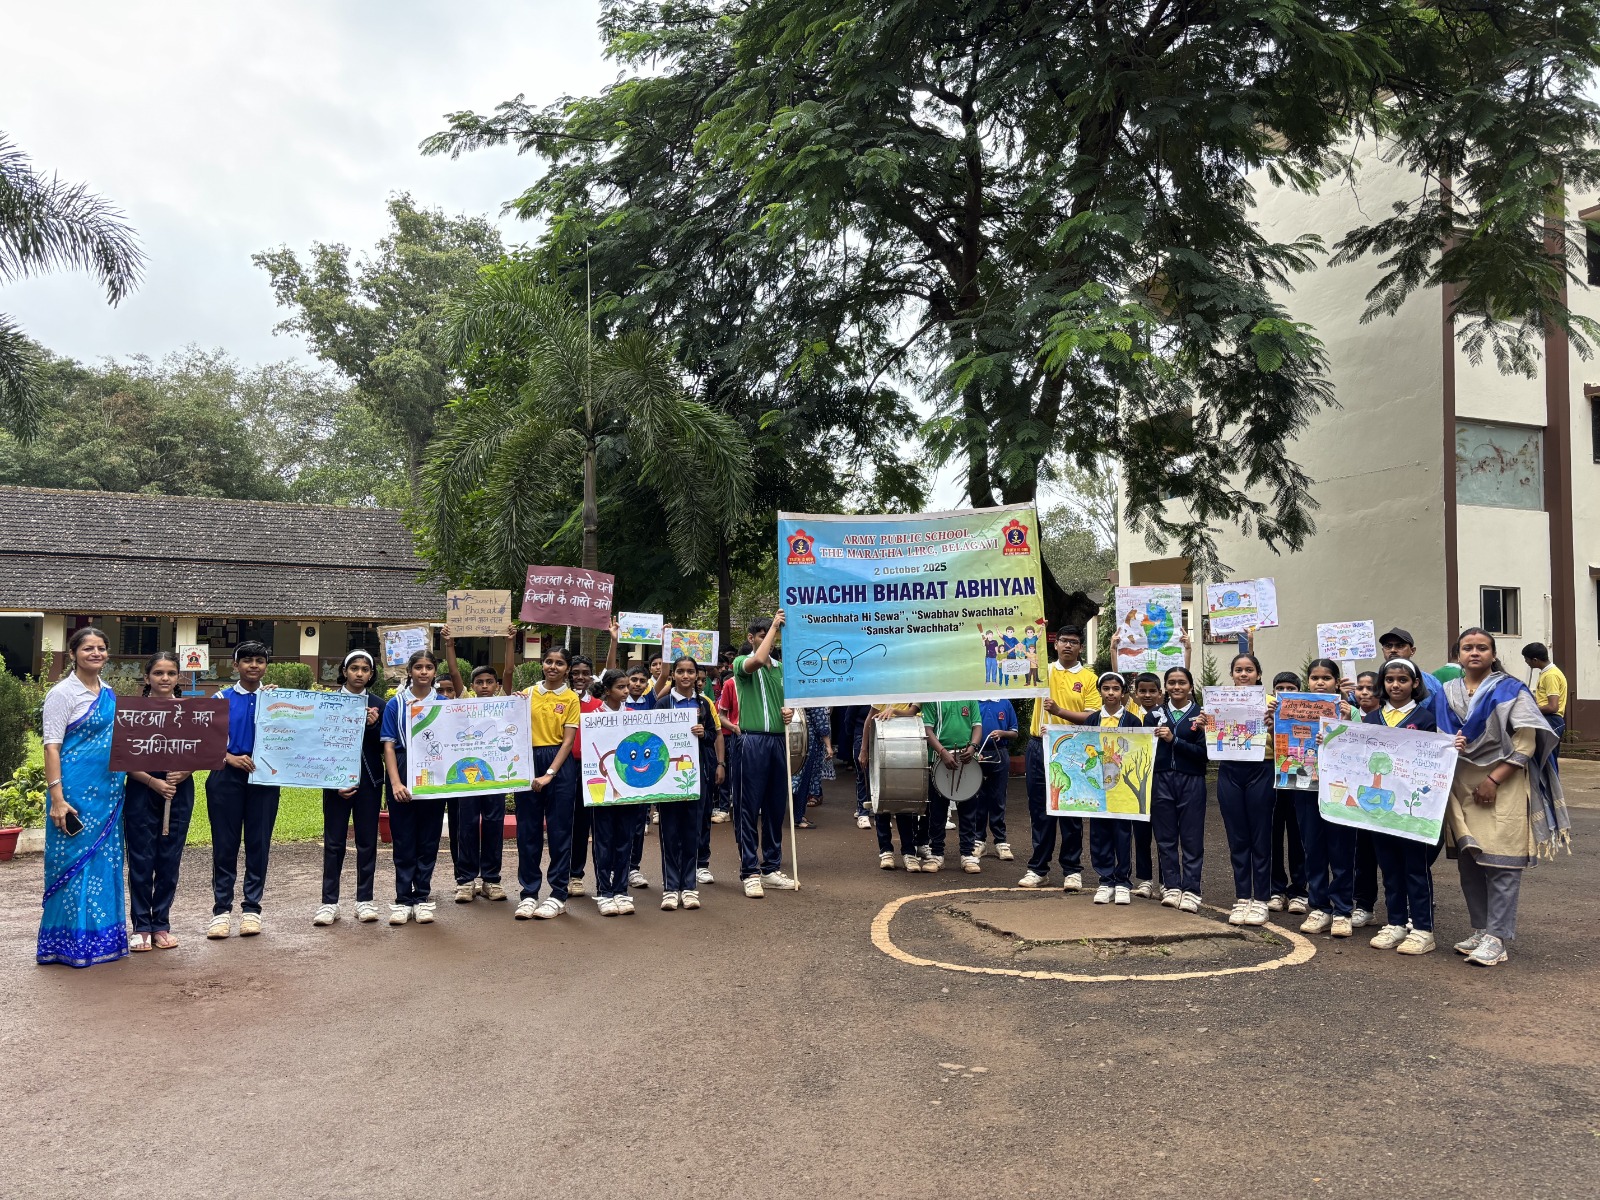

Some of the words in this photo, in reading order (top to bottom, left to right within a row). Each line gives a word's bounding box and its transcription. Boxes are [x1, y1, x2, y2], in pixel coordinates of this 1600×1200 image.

[843, 534, 876, 546] ARMY
[880, 532, 922, 545] PUBLIC
[820, 547, 844, 559] THE
[847, 546, 904, 560] MARATHA
[941, 538, 999, 553] BELAGAVI
[874, 567, 880, 576] 2
[883, 564, 921, 576] October
[923, 561, 947, 573] 2025
[529, 574, 563, 586] स्वच्छता
[564, 573, 574, 587] के
[577, 572, 595, 590] रास्ते
[557, 589, 567, 605] के
[569, 591, 592, 608] वास्ते
[785, 583, 867, 606] SWACHH
[873, 579, 948, 602] BHARAT
[954, 576, 1036, 599] ABHIYAN
[466, 605, 497, 615] Bharat
[862, 611, 872, 622] Hi
[445, 704, 478, 714] SWACHH
[483, 701, 516, 711] BHARAT
[466, 709, 504, 719] ABHIYAN
[174, 704, 186, 728] है
[192, 711, 215, 727] महा
[584, 715, 619, 727] SWACHH
[622, 712, 652, 725] BHARAT
[655, 711, 691, 723] ABHIYAN
